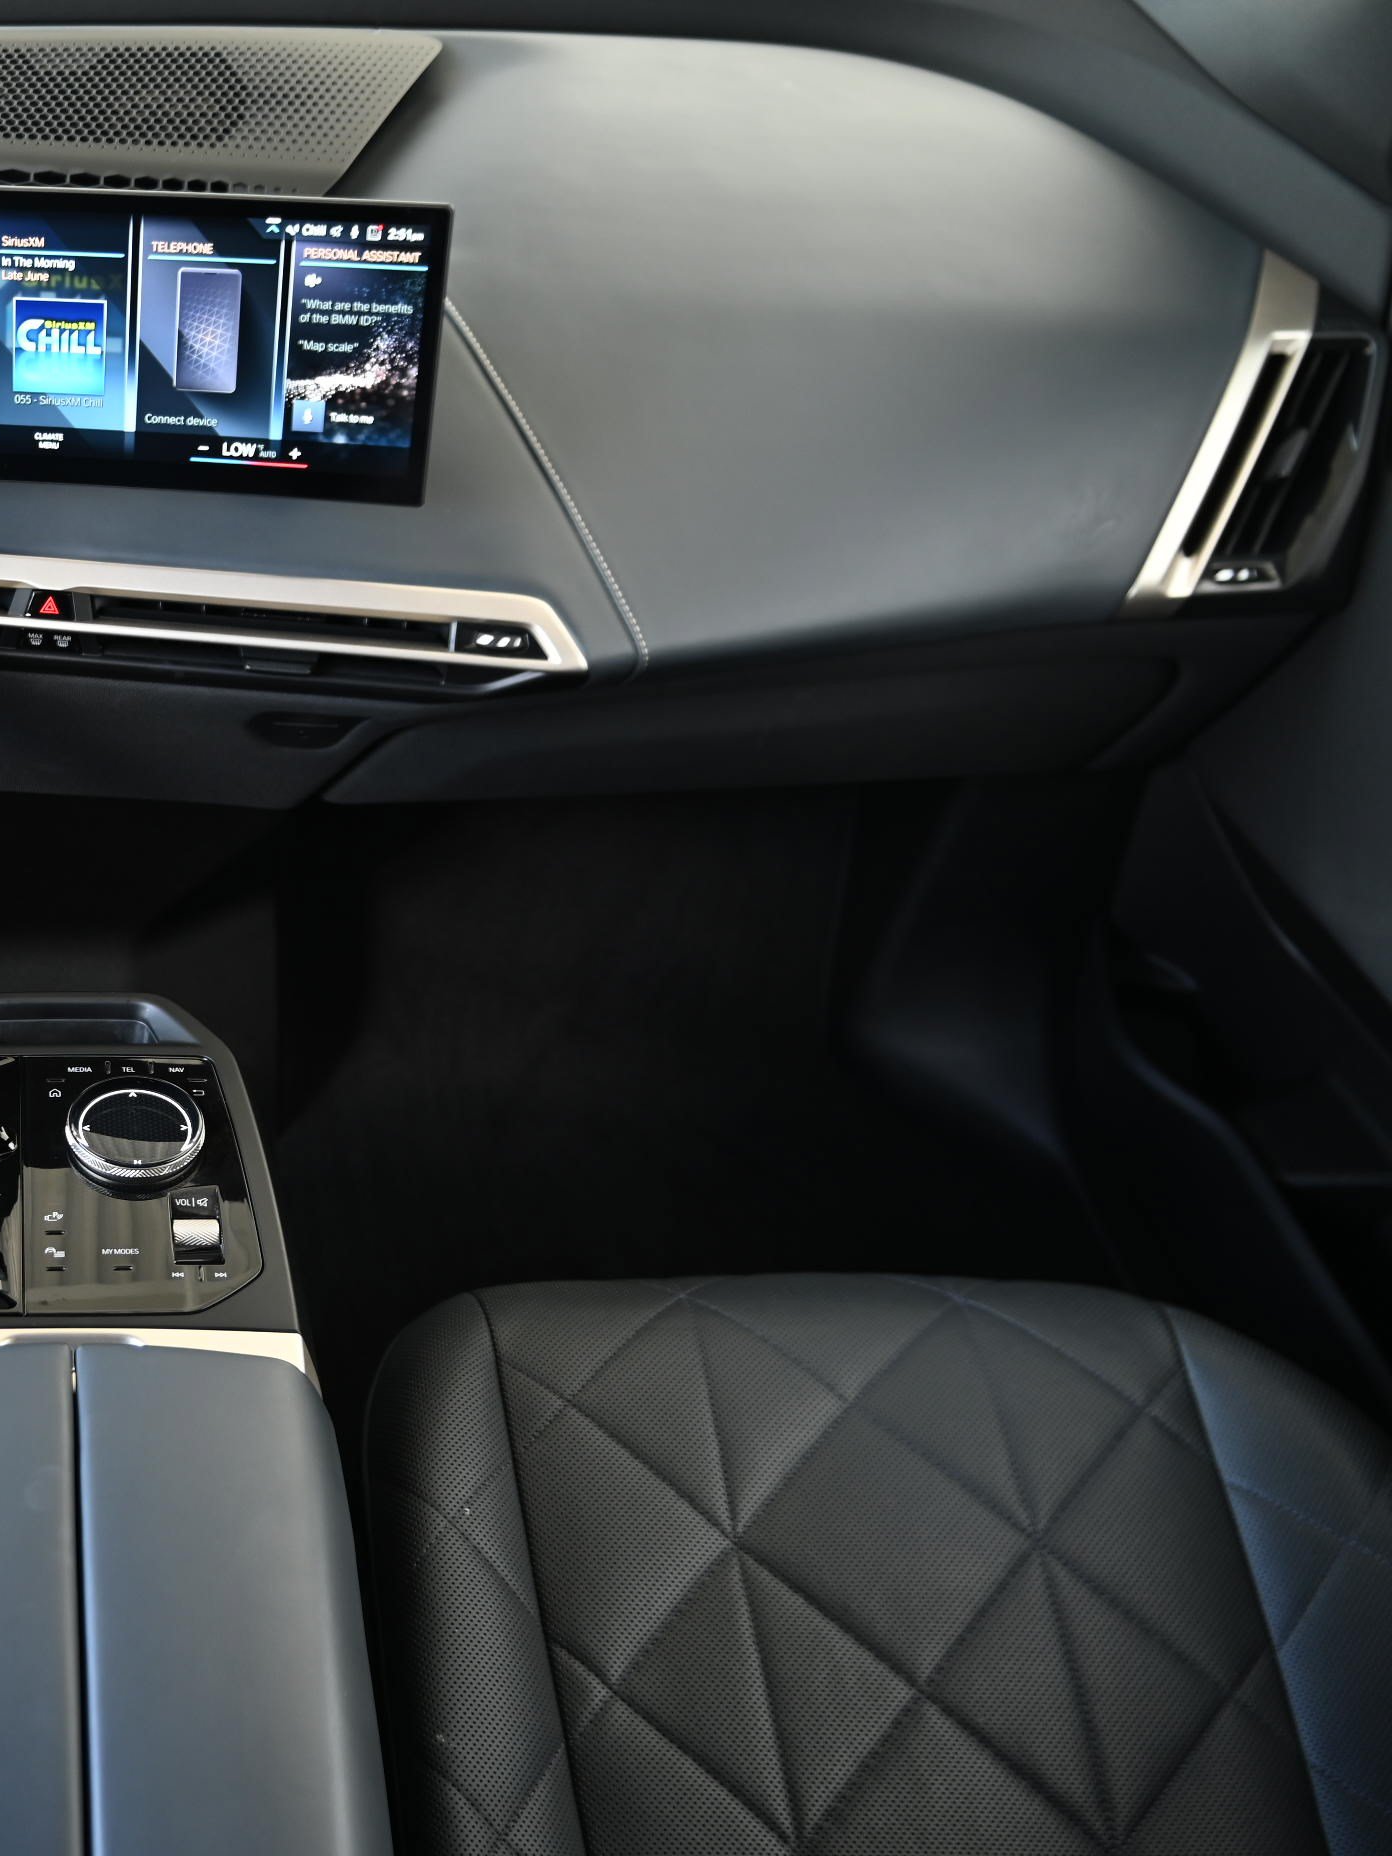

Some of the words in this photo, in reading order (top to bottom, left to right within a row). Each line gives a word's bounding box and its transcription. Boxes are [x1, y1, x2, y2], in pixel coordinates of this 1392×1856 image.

[1, 236, 45, 247] SiriusXM
[152, 241, 213, 254] TELEPHONE
[304, 248, 360, 260] PERSONAL
[360, 250, 421, 263] ASSISTANT
[2, 256, 11, 267] In
[13, 256, 33, 267] The
[34, 257, 75, 271] Morning
[2, 270, 23, 280] Late
[24, 271, 49, 282] June
[335, 302, 351, 311] are
[353, 302, 370, 312] the
[372, 302, 414, 315] benefits
[45, 320, 95, 330] SiriusXM
[300, 313, 310, 323] of
[312, 313, 329, 324] the
[331, 314, 358, 325] BMW
[16, 318, 102, 354] CHILL
[14, 394, 32, 405] 055
[39, 396, 82, 406] SiriusXM
[83, 398, 104, 408] Chill
[144, 413, 185, 425] Connect
[186, 415, 219, 427] device
[348, 414, 359, 423] to
[39, 441, 60, 450] MENU
[221, 441, 257, 458] LOW
[259, 450, 277, 458] AUTO
[175, 1198, 192, 1207] VOL
[101, 1247, 114, 1256] MY
[114, 1247, 140, 1256] MODES
